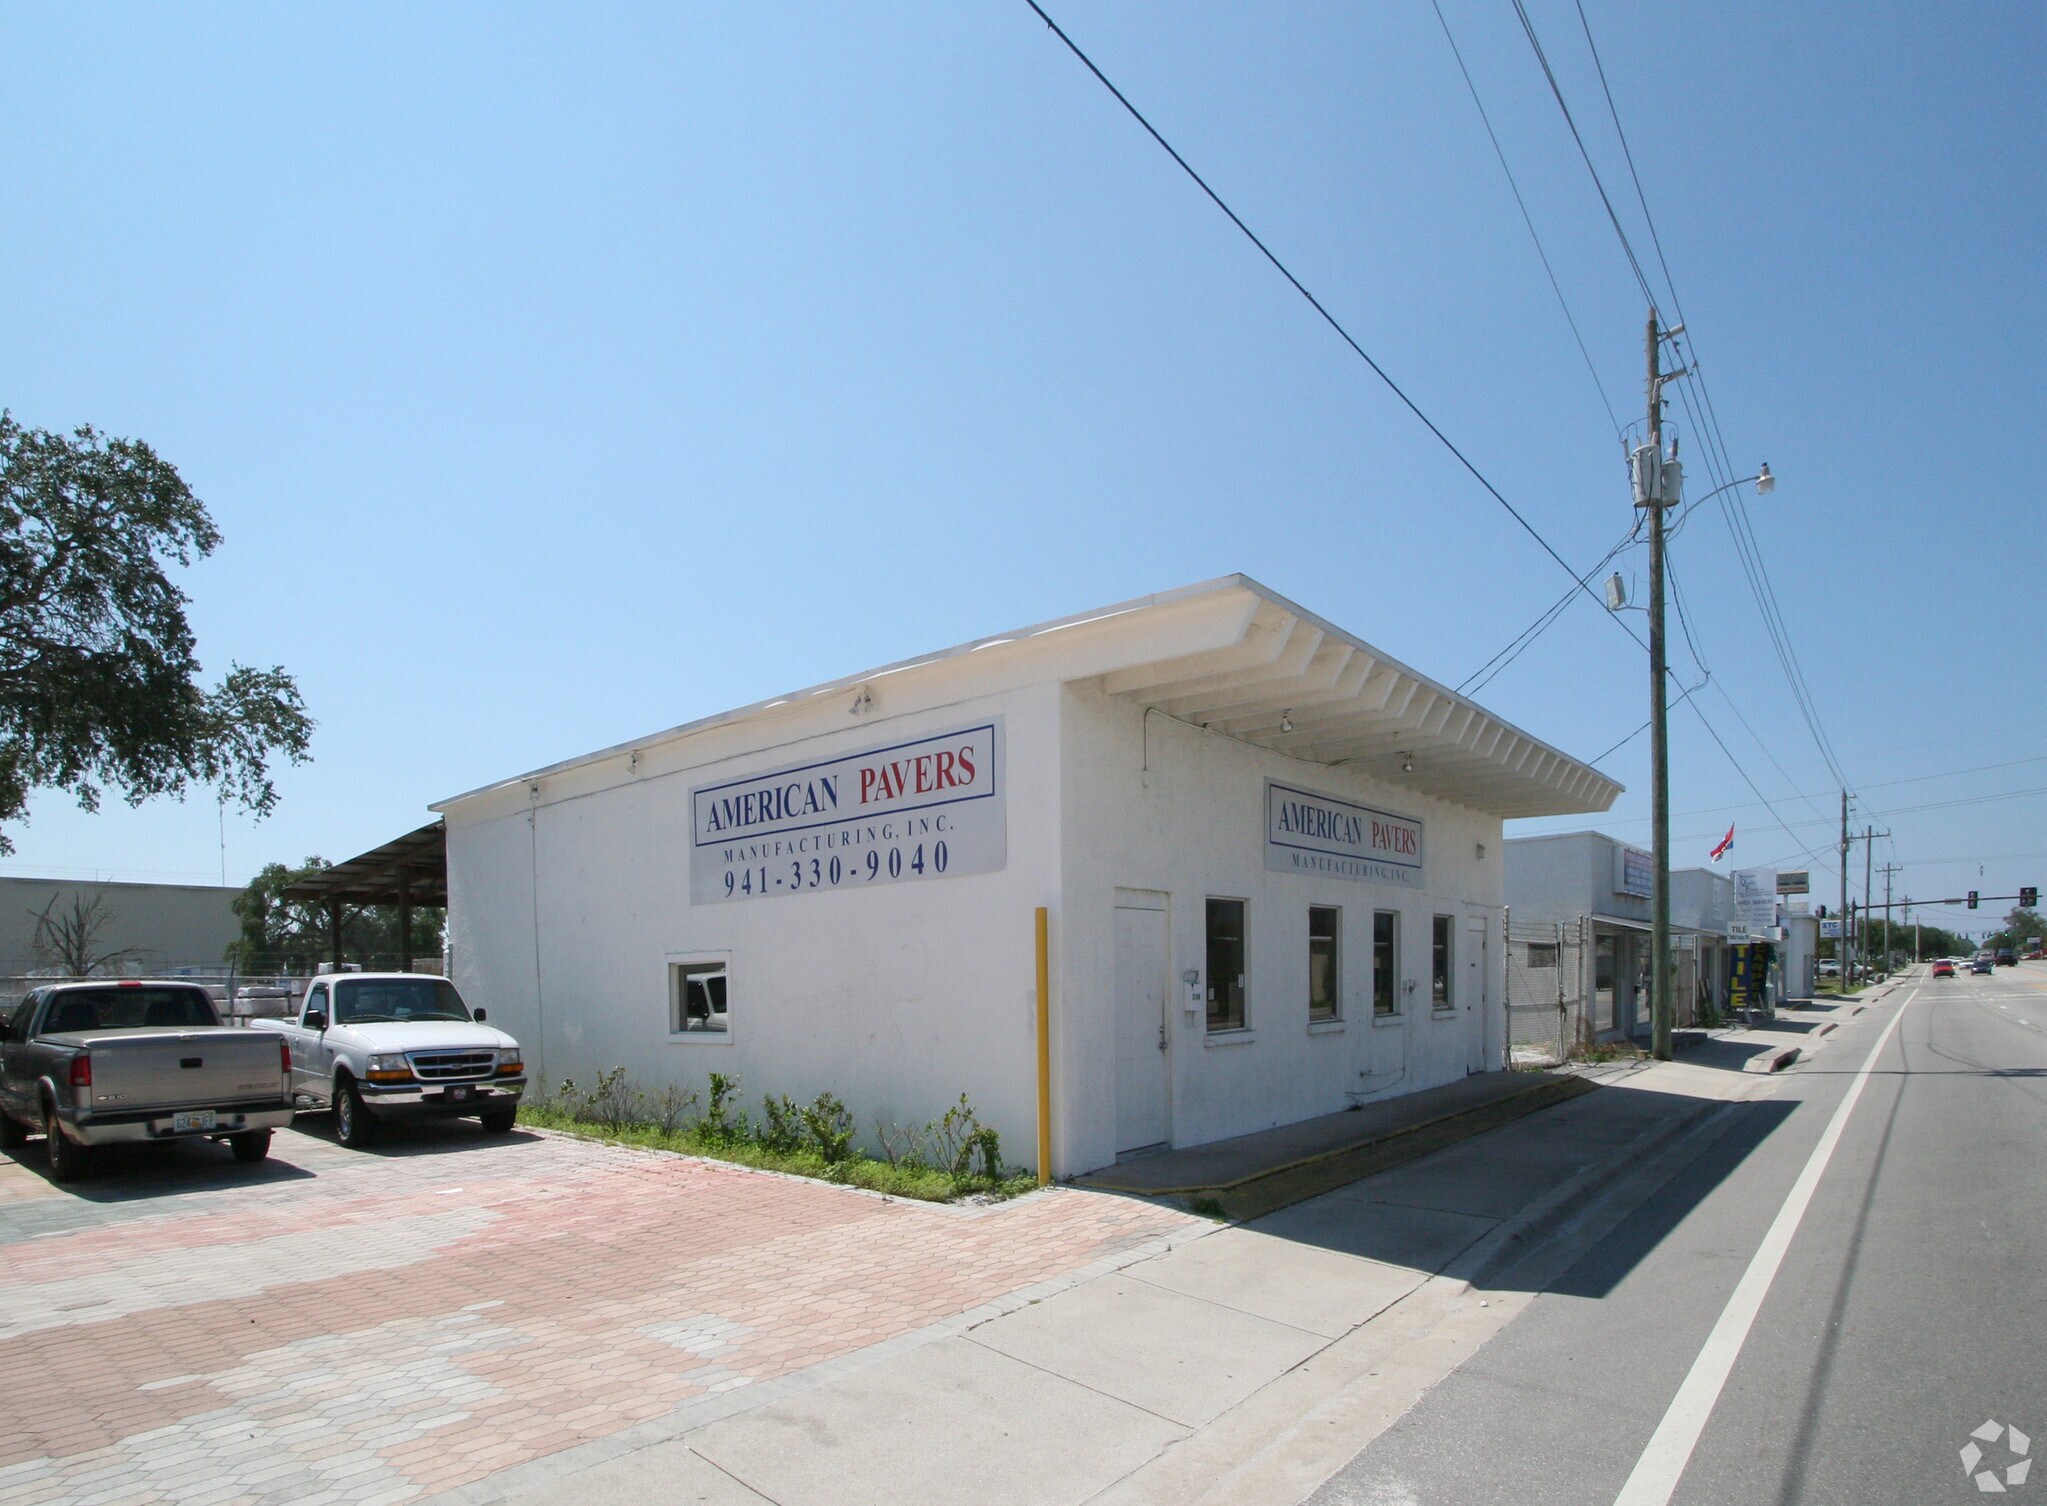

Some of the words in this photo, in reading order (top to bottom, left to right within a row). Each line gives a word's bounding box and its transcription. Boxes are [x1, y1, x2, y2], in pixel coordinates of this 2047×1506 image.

[706, 775, 839, 832] AMERICAN
[859, 745, 976, 804] PAVERS
[907, 814, 955, 836] INC.
[1278, 800, 1362, 845] AMERICAN
[1371, 821, 1417, 856] PAVERS
[724, 840, 949, 898] 941-330-9040
[1731, 925, 1747, 933] TILE
[1730, 944, 1748, 1007] TILE
